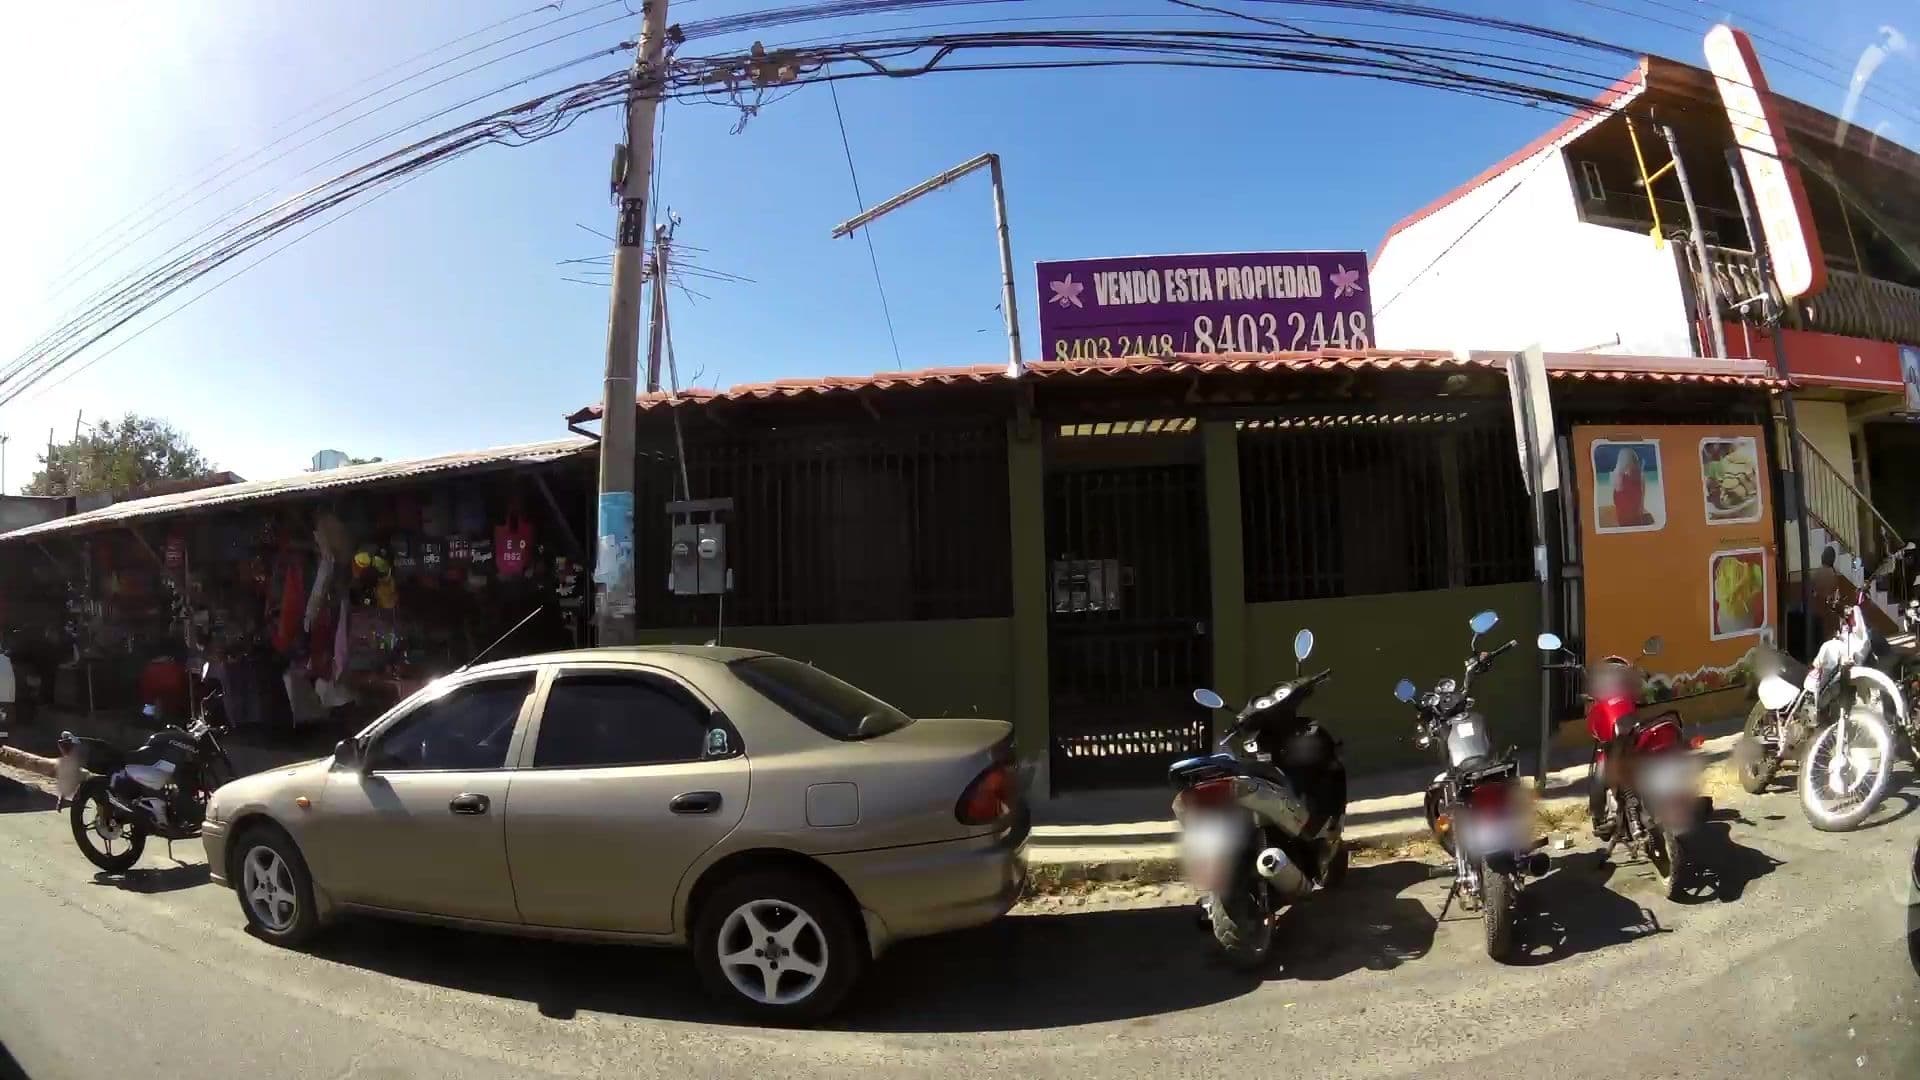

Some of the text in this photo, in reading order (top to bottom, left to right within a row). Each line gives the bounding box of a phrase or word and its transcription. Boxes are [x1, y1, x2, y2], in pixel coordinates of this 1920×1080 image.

[1093, 265, 1322, 306] VENDO ESTA PROPIEDAD
